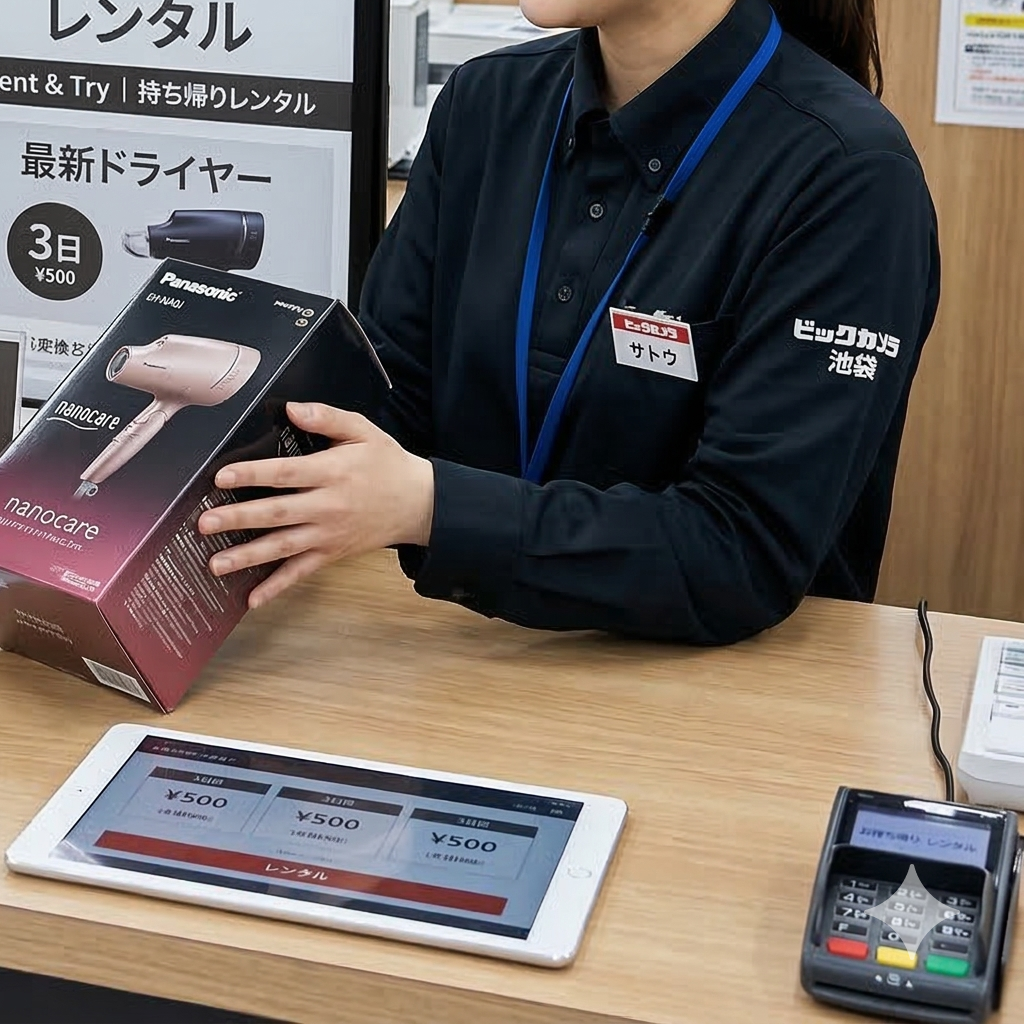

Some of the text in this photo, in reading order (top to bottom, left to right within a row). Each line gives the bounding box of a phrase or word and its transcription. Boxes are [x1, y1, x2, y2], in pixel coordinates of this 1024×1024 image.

[46, 74, 64, 96] &
[70, 75, 111, 106] Try
[138, 78, 317, 118] 持ち帰りレンタル
[20, 141, 272, 194] 最新ドライヤー
[28, 222, 81, 266] 3日
[34, 266, 76, 286] ¥500
[160, 271, 240, 303] Panasonic
[629, 341, 677, 366] サトウ
[827, 349, 878, 381] 池袋
[54, 399, 122, 432] nanocare
[4, 497, 100, 540] nanocare
[164, 788, 228, 809] ¥500
[296, 810, 360, 830] ¥500
[431, 831, 497, 853] ¥500
[265, 863, 329, 881] レンタル
